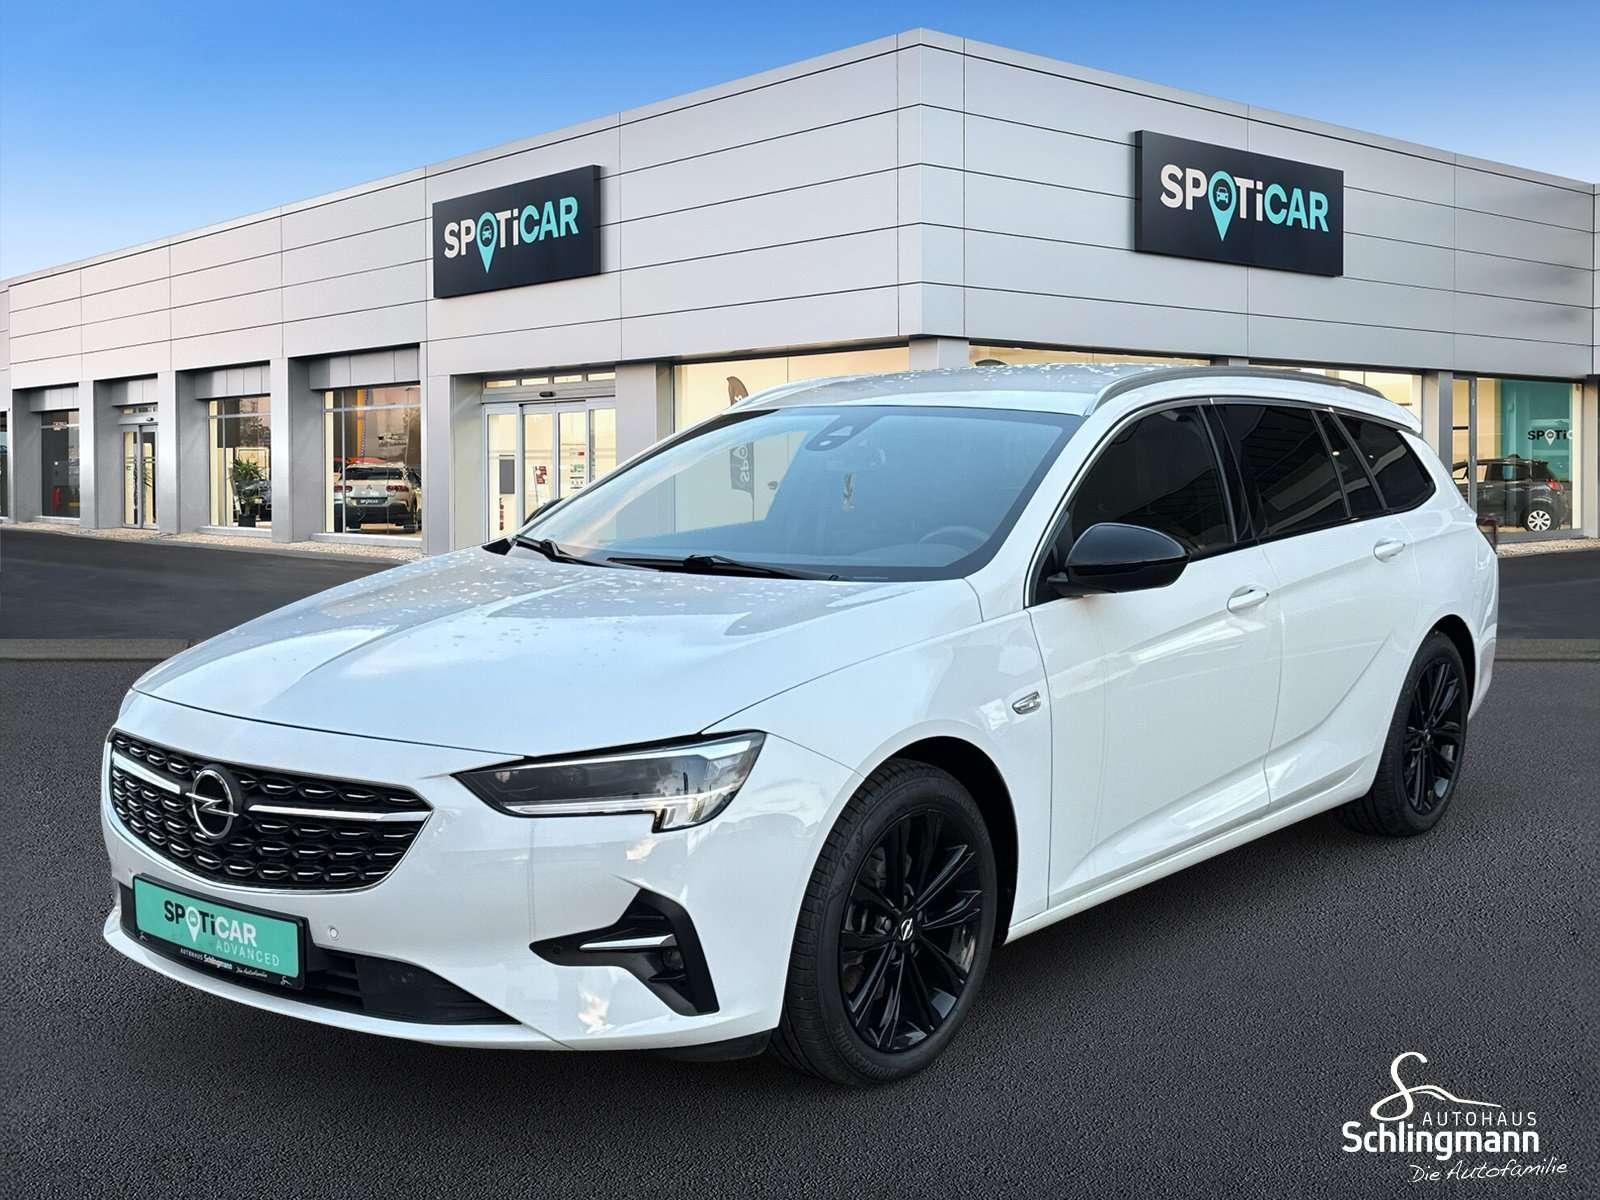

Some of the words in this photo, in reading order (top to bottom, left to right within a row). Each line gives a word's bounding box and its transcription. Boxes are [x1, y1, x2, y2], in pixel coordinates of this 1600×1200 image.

[1160, 164, 1329, 242] SPOTiCAR
[444, 196, 579, 273] SPOTiCAR
[164, 900, 257, 946] SPOTiCAR
[215, 940, 280, 967] ADVANCED
